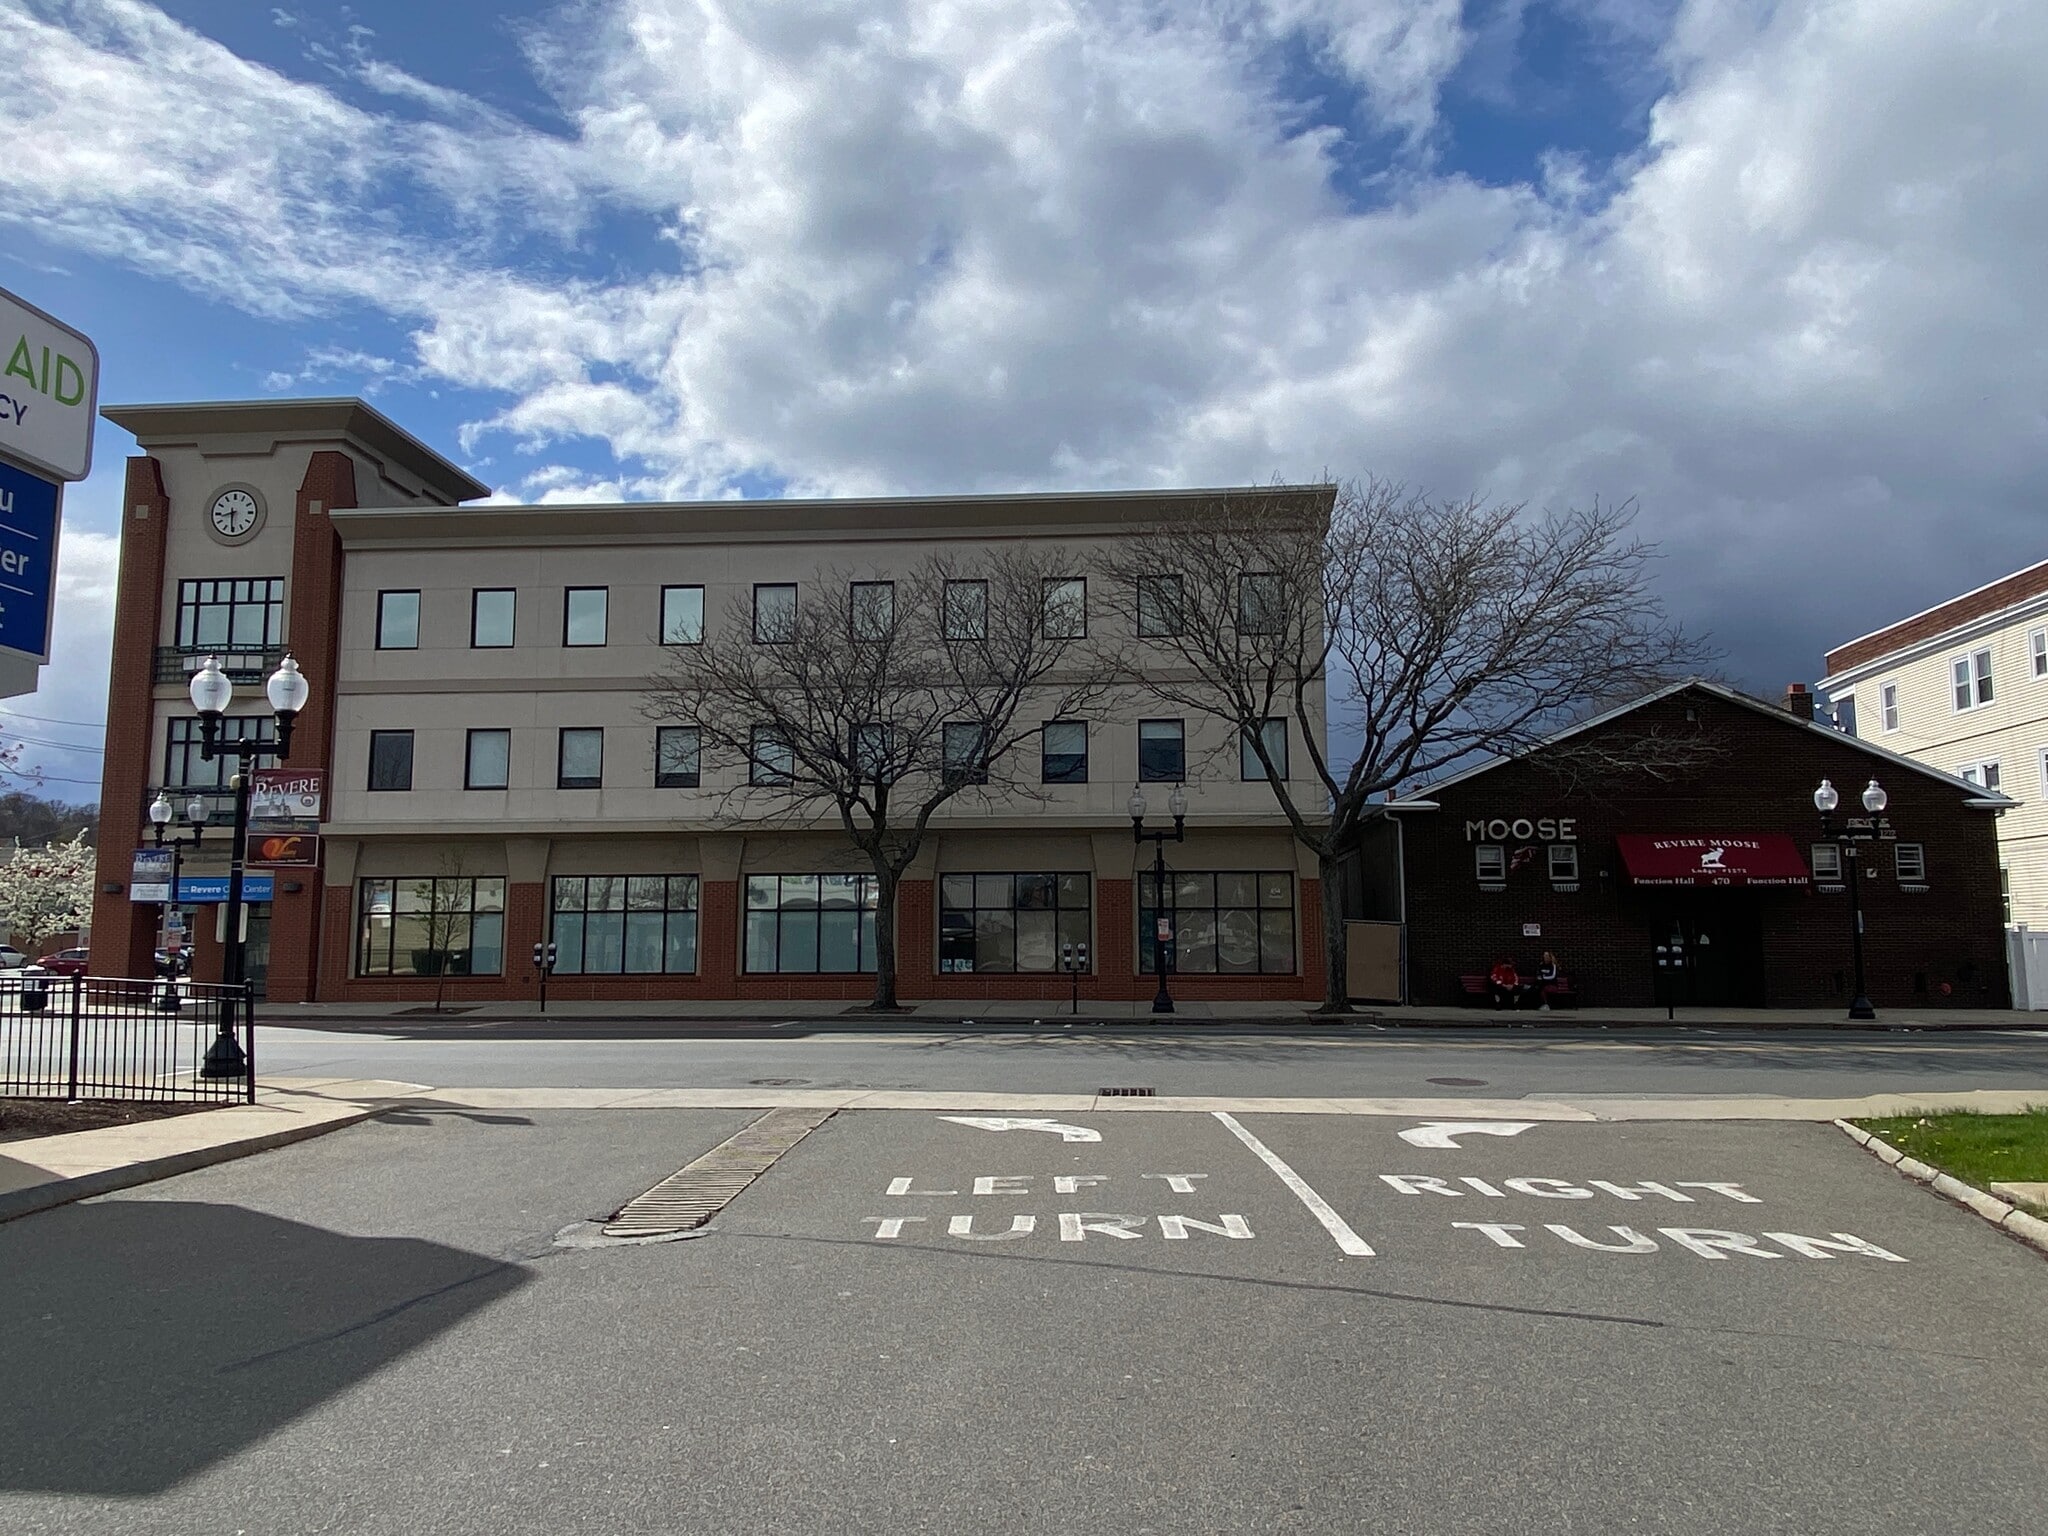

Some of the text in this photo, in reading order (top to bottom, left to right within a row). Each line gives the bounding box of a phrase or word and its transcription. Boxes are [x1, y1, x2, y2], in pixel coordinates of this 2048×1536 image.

[4, 334, 85, 406] AID
[255, 778, 320, 798] REVERE
[1465, 818, 1578, 841] MOOSE
[1653, 839, 1761, 849] REVERE MOOSE
[190, 885, 222, 894] Revere
[243, 885, 272, 893] Center
[1633, 877, 1695, 885] Function Hall
[1711, 877, 1730, 885] 470
[1747, 876, 1809, 885] Function Hall
[886, 1174, 1208, 1195] LEFT
[1378, 1174, 1763, 1203] RIGHT
[860, 1212, 1255, 1241] TURN
[1451, 1221, 1909, 1262] TURN
